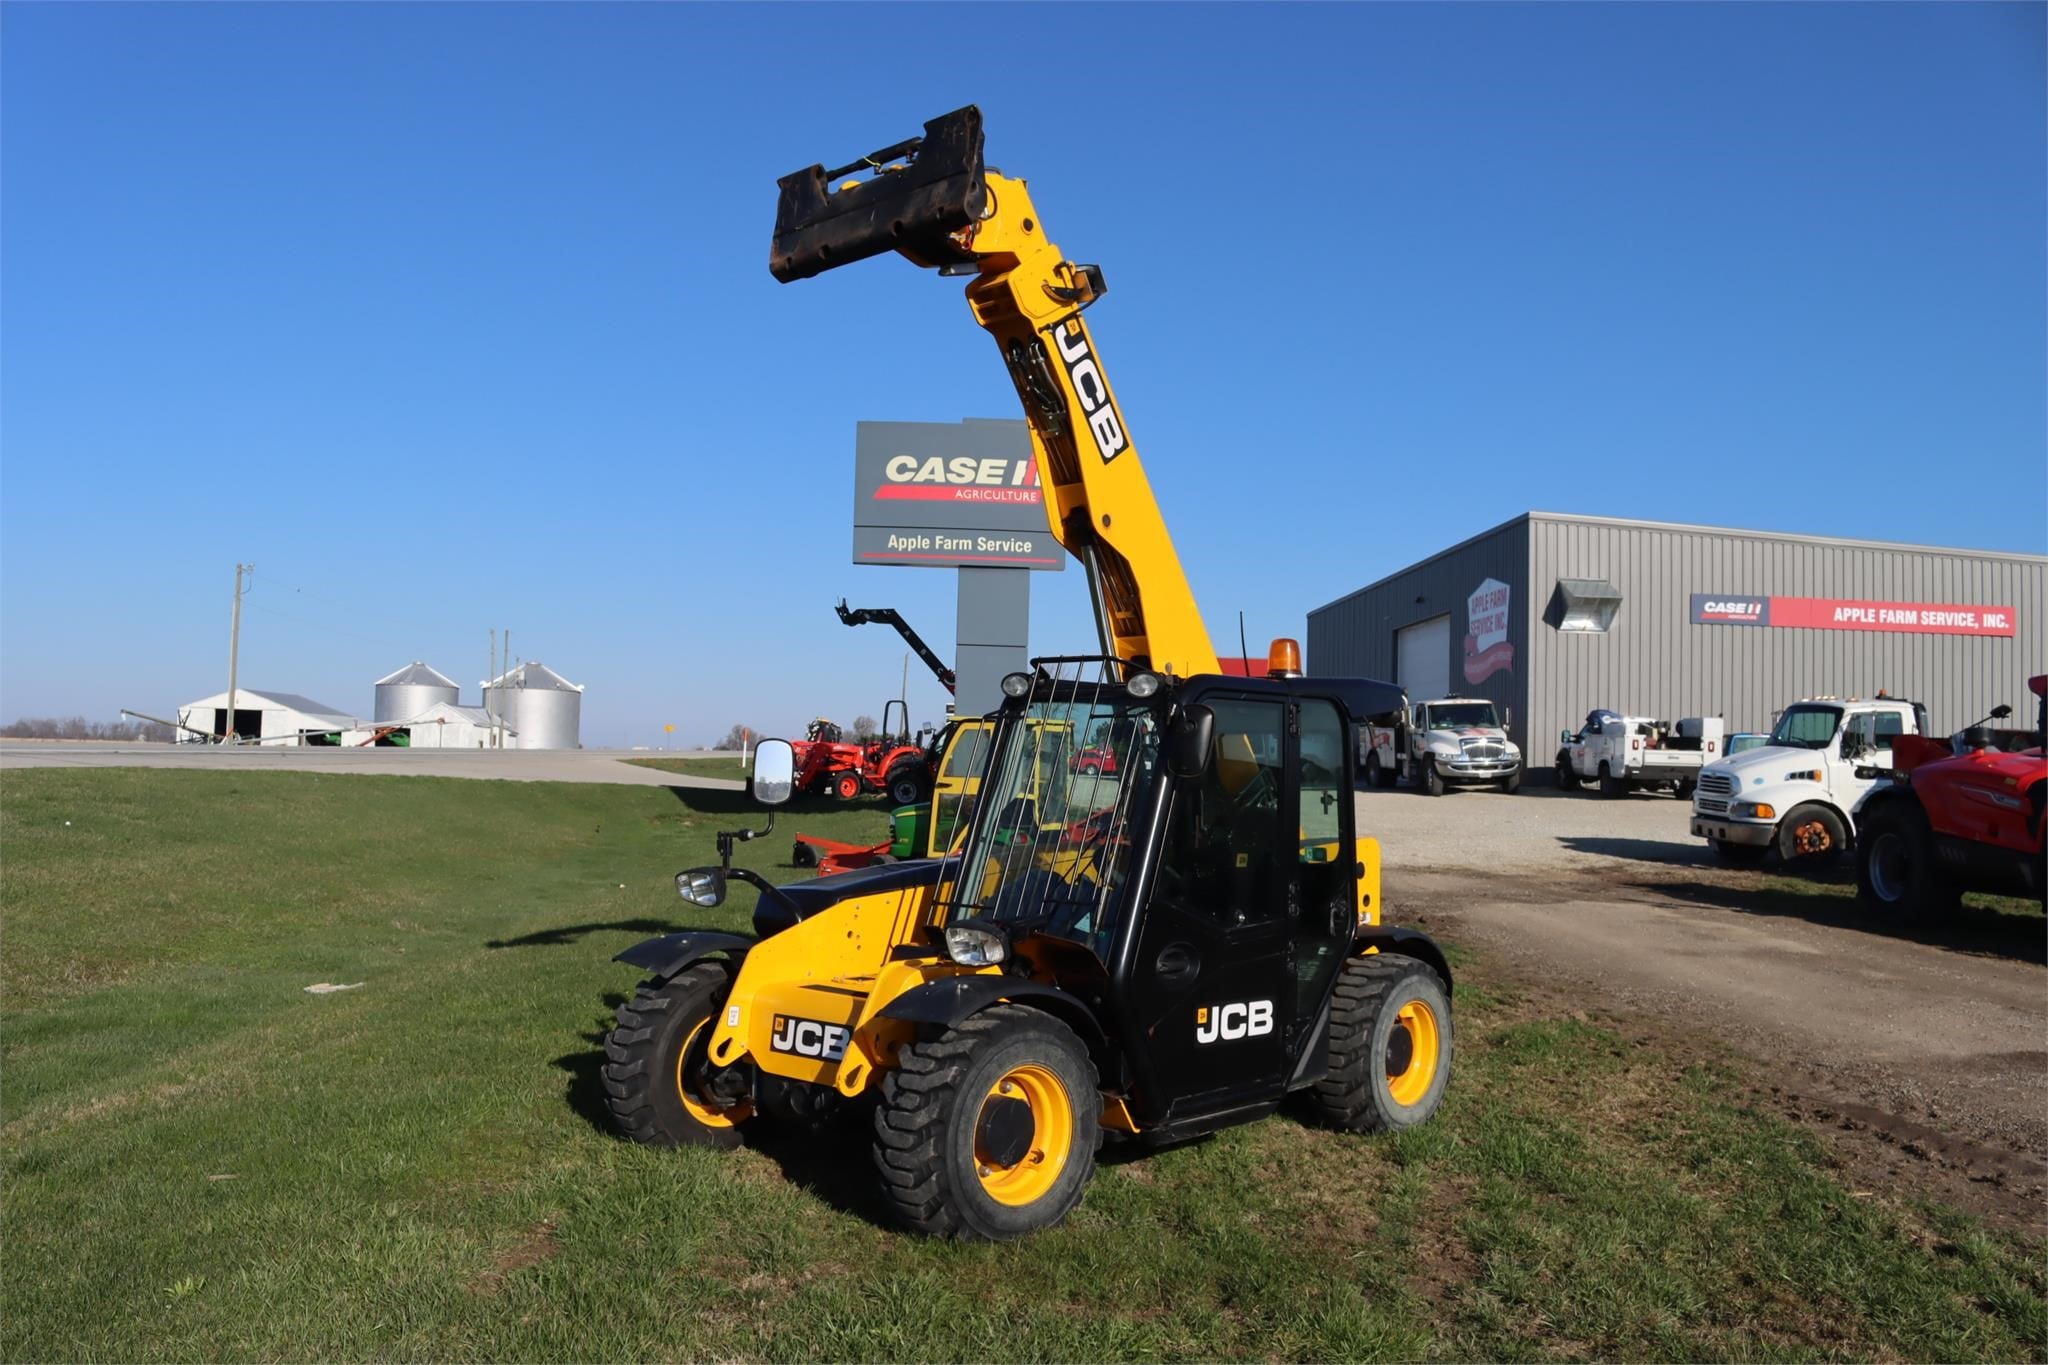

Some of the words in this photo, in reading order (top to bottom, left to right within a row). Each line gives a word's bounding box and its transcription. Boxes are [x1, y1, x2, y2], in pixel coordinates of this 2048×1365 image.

[1055, 324, 1124, 459] JCB
[885, 455, 1008, 485] CASE
[954, 488, 1038, 502] AGRICULTURE
[887, 534, 930, 552] Apple
[935, 536, 973, 551] Farm
[976, 536, 1032, 553] Service
[1704, 601, 1747, 614] CASE
[1833, 606, 1878, 624] APPLE
[1879, 608, 1917, 626] FARM
[1920, 610, 1979, 630] SERVICE,
[1982, 613, 2010, 629] INC.
[1197, 1000, 1273, 1044] JCB
[773, 1018, 850, 1061] JCB
